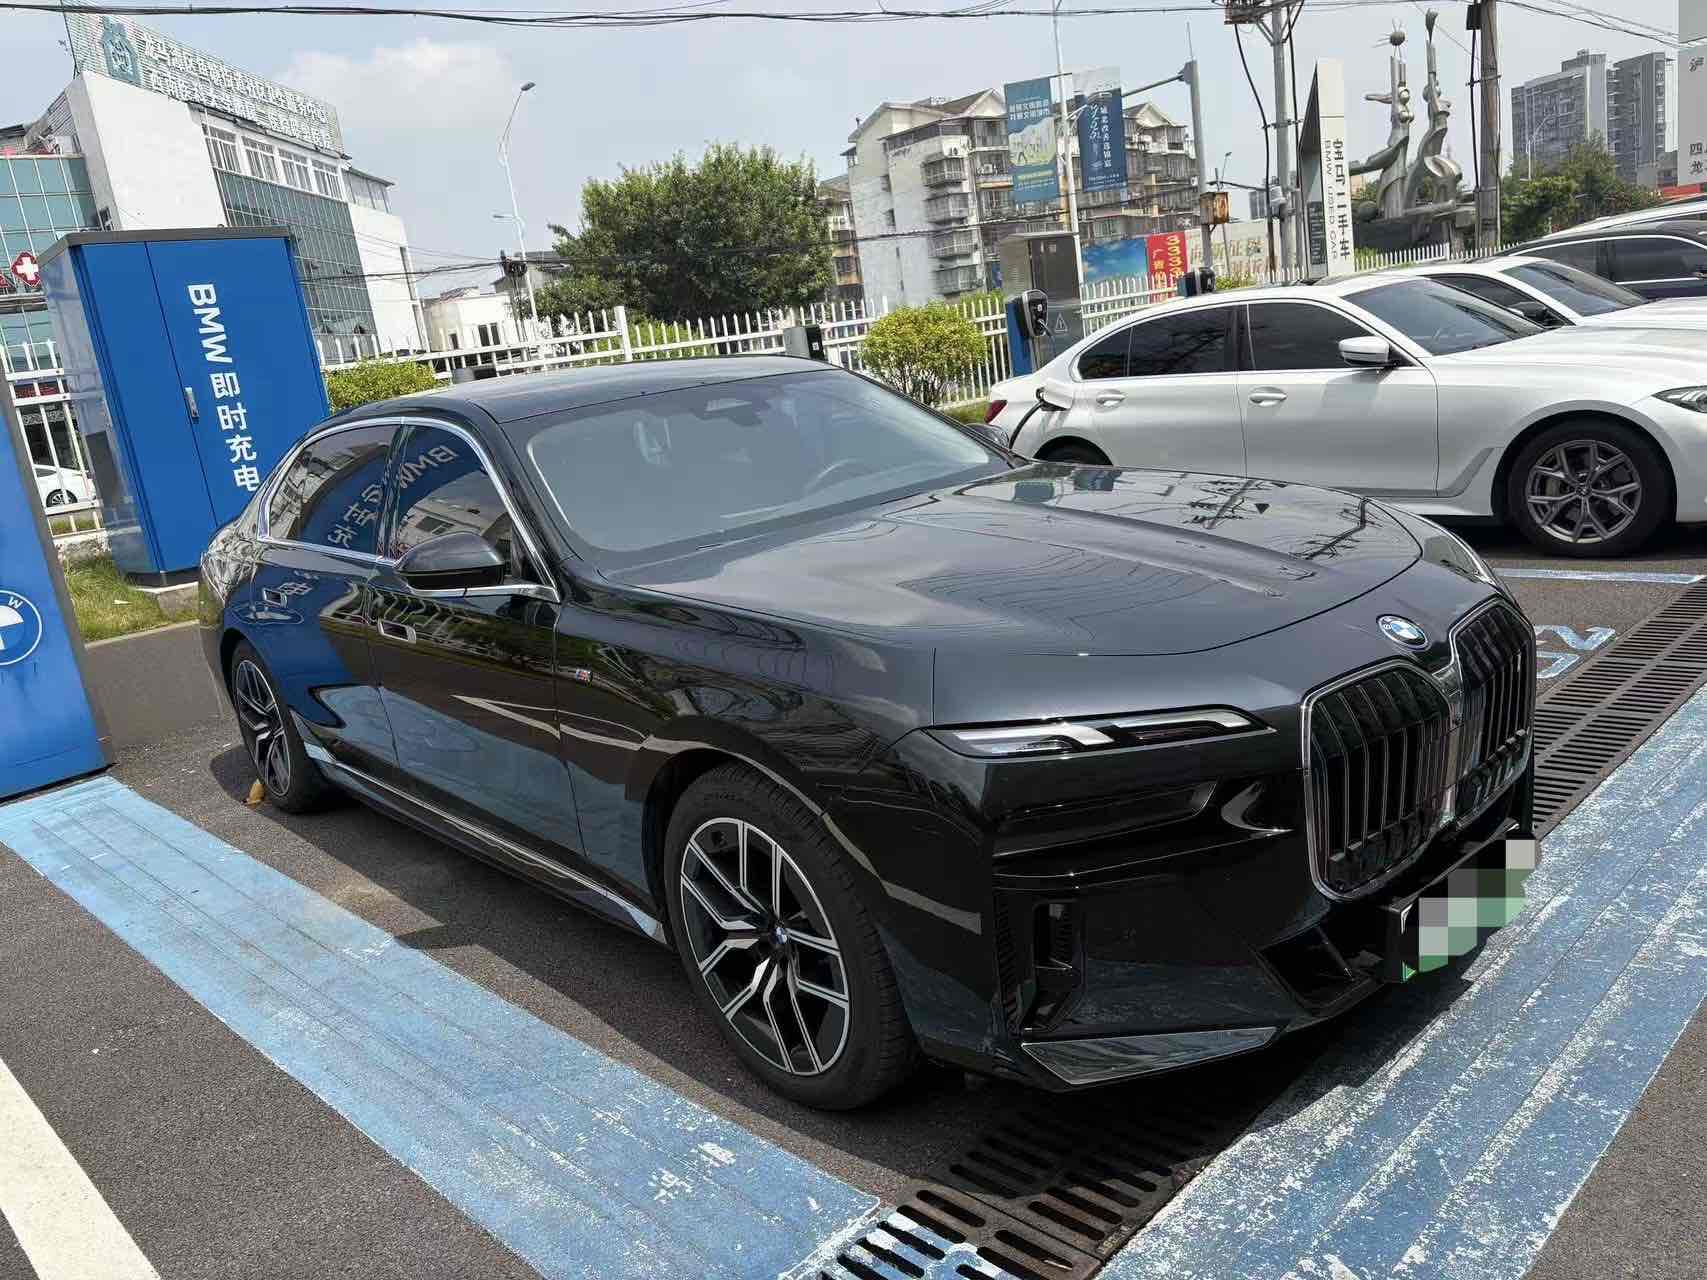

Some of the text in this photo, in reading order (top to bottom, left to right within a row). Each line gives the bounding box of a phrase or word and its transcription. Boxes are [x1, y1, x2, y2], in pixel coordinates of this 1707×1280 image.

[1324, 140, 1339, 261] BMW USED CAR
[187, 283, 233, 364] BMW
[209, 372, 262, 492] 即时充电
